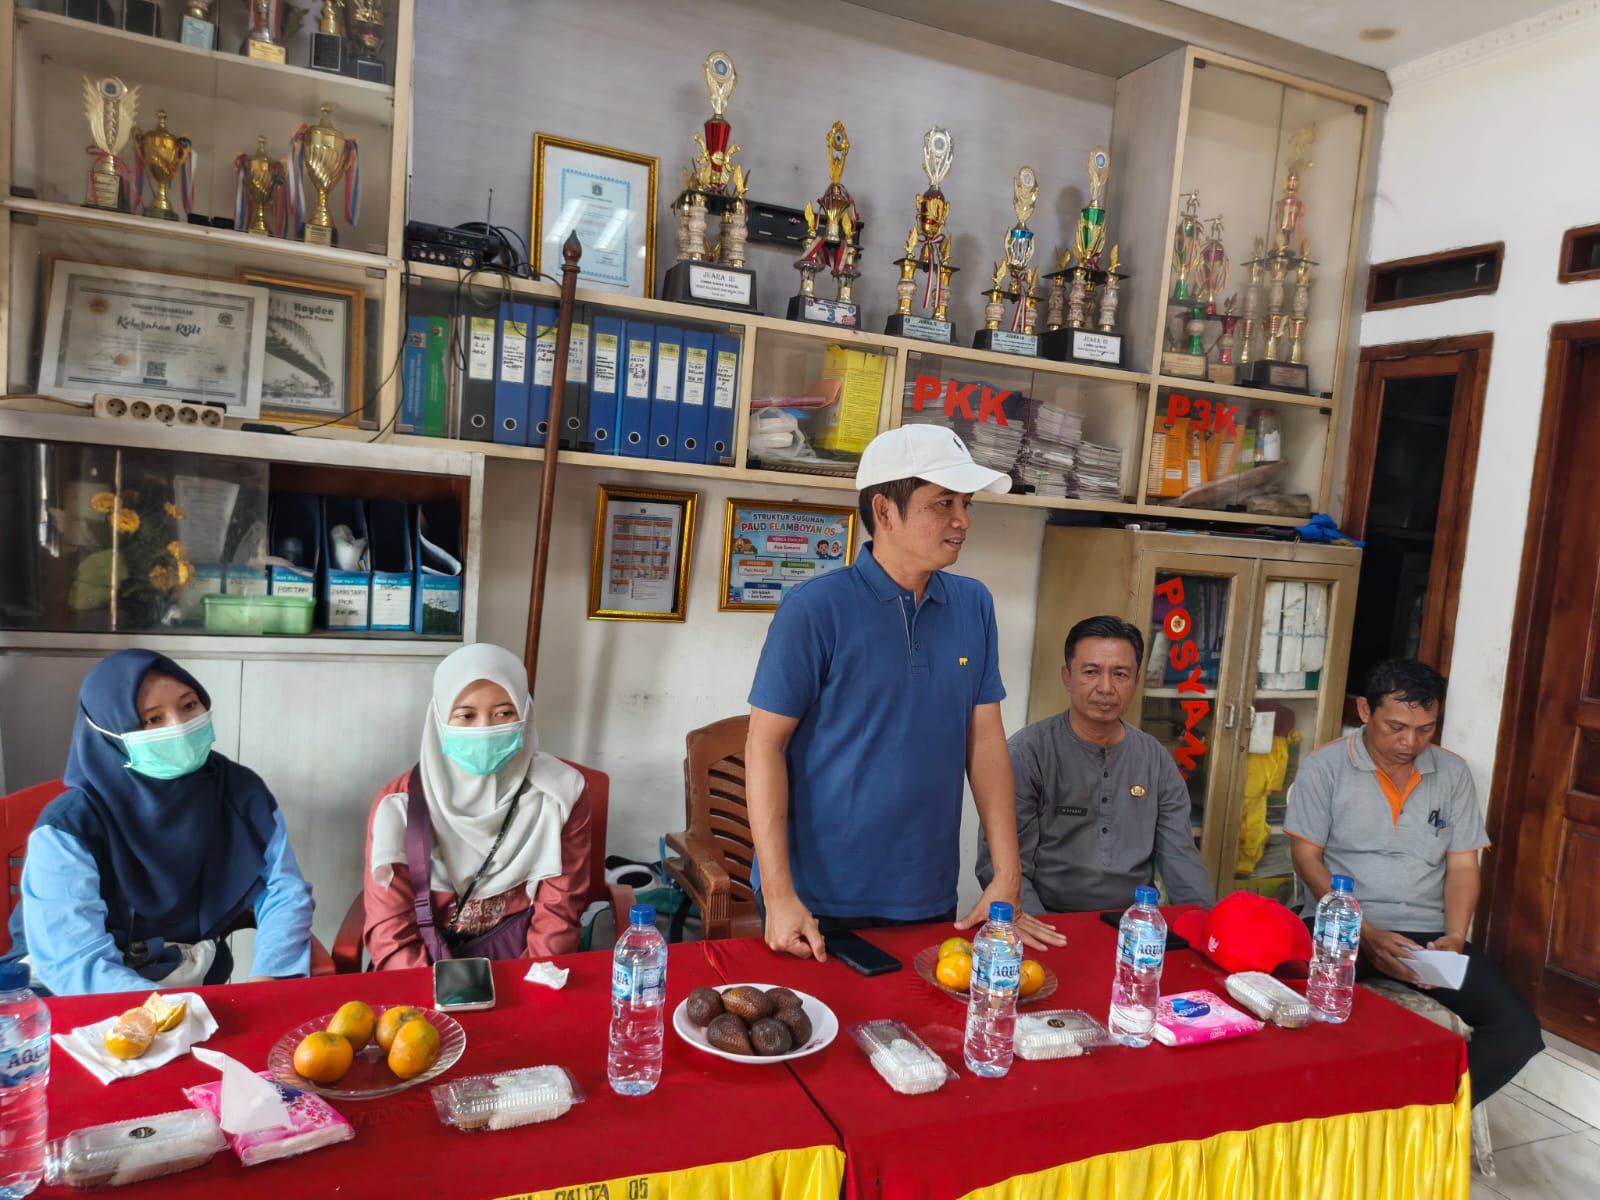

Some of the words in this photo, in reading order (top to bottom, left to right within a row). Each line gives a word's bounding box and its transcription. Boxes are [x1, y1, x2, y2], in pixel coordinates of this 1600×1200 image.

[912, 374, 1013, 427] PKK
[1166, 393, 1241, 437] P3K
[741, 522, 767, 531] PAUD
[769, 522, 823, 534] FLAMBOYAN
[753, 513, 790, 521] STRUKTUR
[792, 514, 825, 524] SUSUNAN
[1155, 576, 1211, 781] POSYAN
[1137, 944, 1163, 957] AQUA
[992, 964, 1020, 978] AQUA
[7, 1043, 49, 1069] AQU
[629, 1177, 649, 1200] 05
